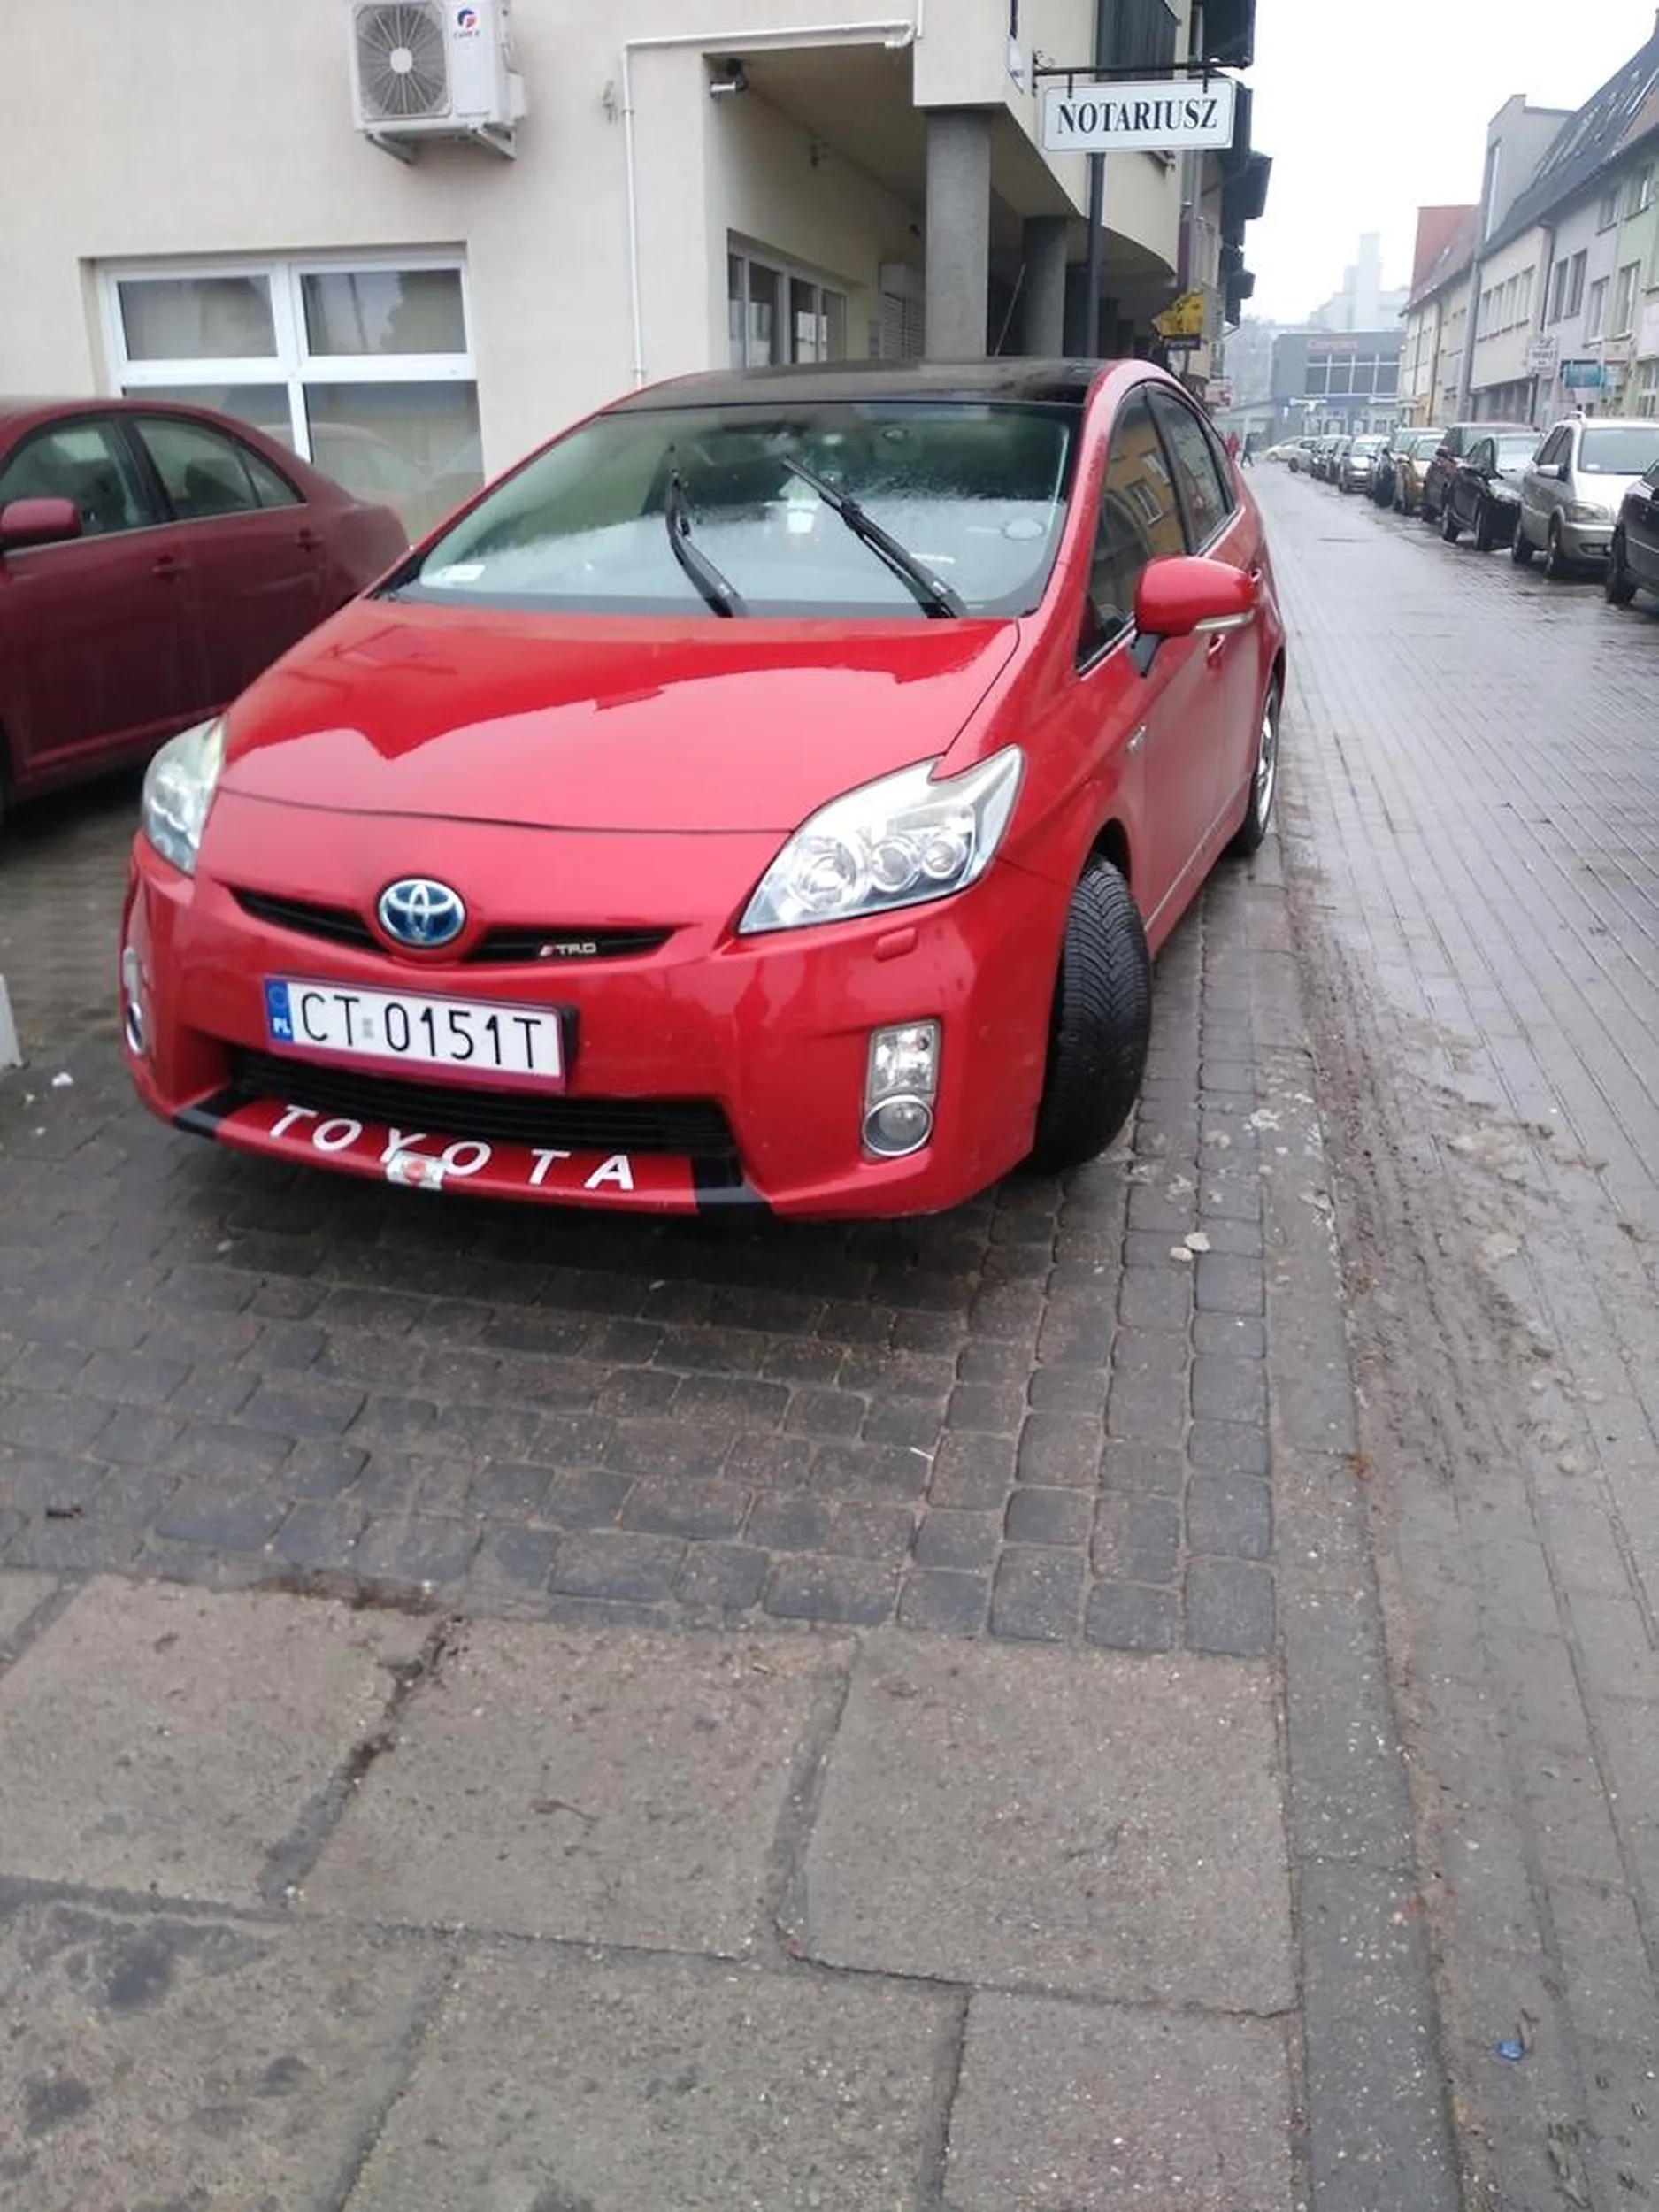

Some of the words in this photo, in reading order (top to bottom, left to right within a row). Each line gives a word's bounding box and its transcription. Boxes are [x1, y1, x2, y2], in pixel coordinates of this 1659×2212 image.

[1057, 98, 1218, 134] NOTARIUSZ
[273, 1017, 291, 1033] PL
[301, 992, 359, 1046] CT
[384, 1002, 541, 1069] 0151T
[269, 1104, 634, 1191] TOYOTA
